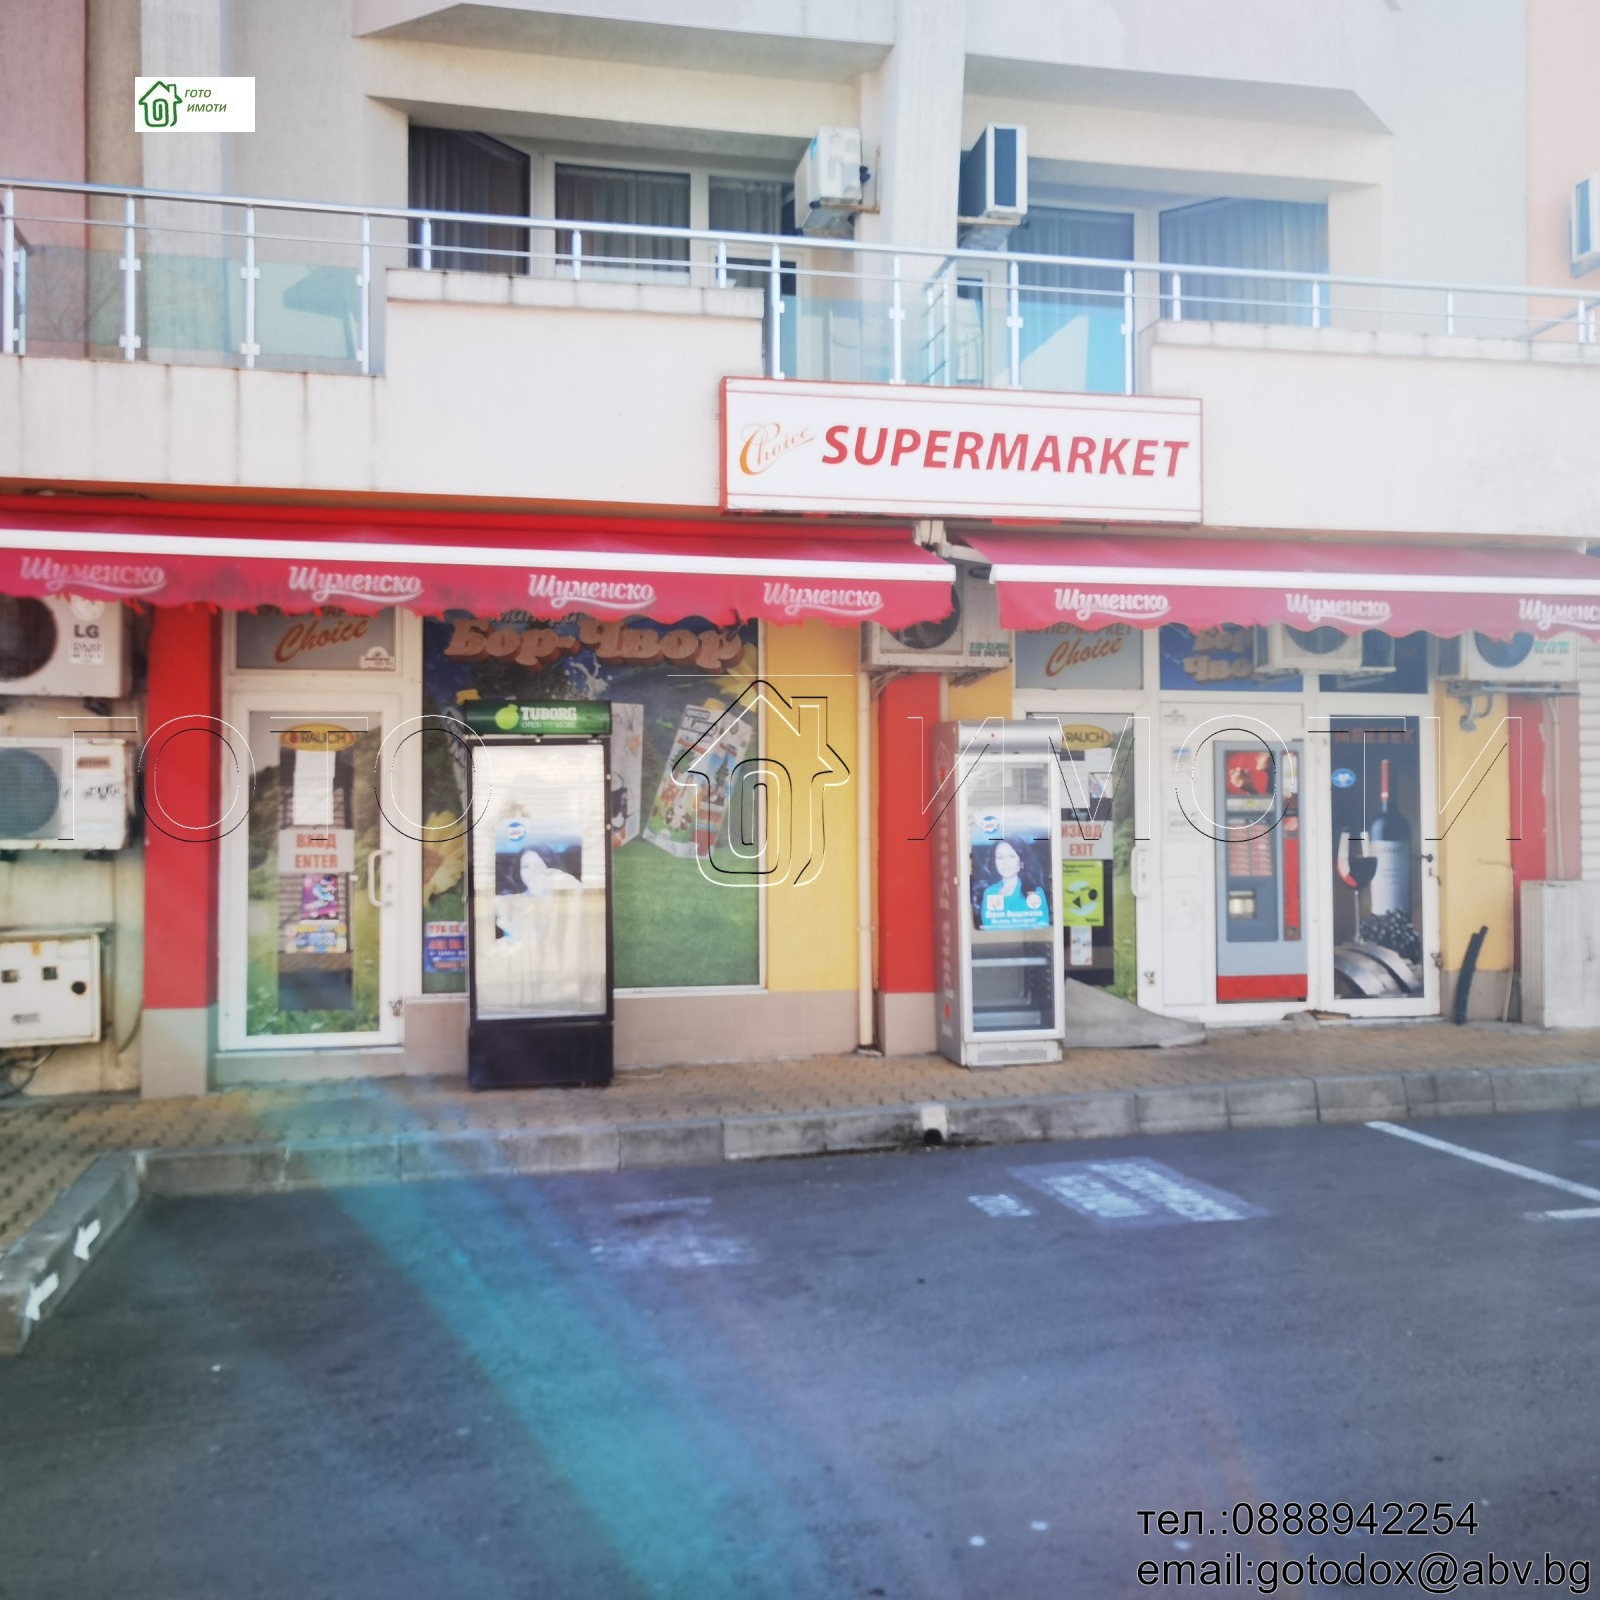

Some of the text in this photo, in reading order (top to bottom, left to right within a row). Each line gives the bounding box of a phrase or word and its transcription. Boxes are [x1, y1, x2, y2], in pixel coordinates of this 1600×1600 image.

[739, 422, 1189, 477] Choice SUPERMARKET
[20, 556, 167, 594] Шуменско
[289, 566, 424, 603] Шуменско
[528, 574, 656, 609] Шуменско
[763, 583, 884, 616] Шуменско
[1054, 588, 1171, 622] Шуменско
[1284, 593, 1392, 625] Шуменско
[74, 624, 99, 638] LG
[274, 616, 369, 663] Choice
[1045, 636, 1123, 673] Choice
[521, 707, 577, 720] TUBORG
[301, 731, 346, 743] RAUCH
[1065, 731, 1105, 742] RAUCH
[296, 833, 337, 849] ВХОД
[1061, 824, 1102, 839] ИЗХОД
[295, 854, 338, 868] ENTER
[1069, 843, 1094, 856] EXIT
